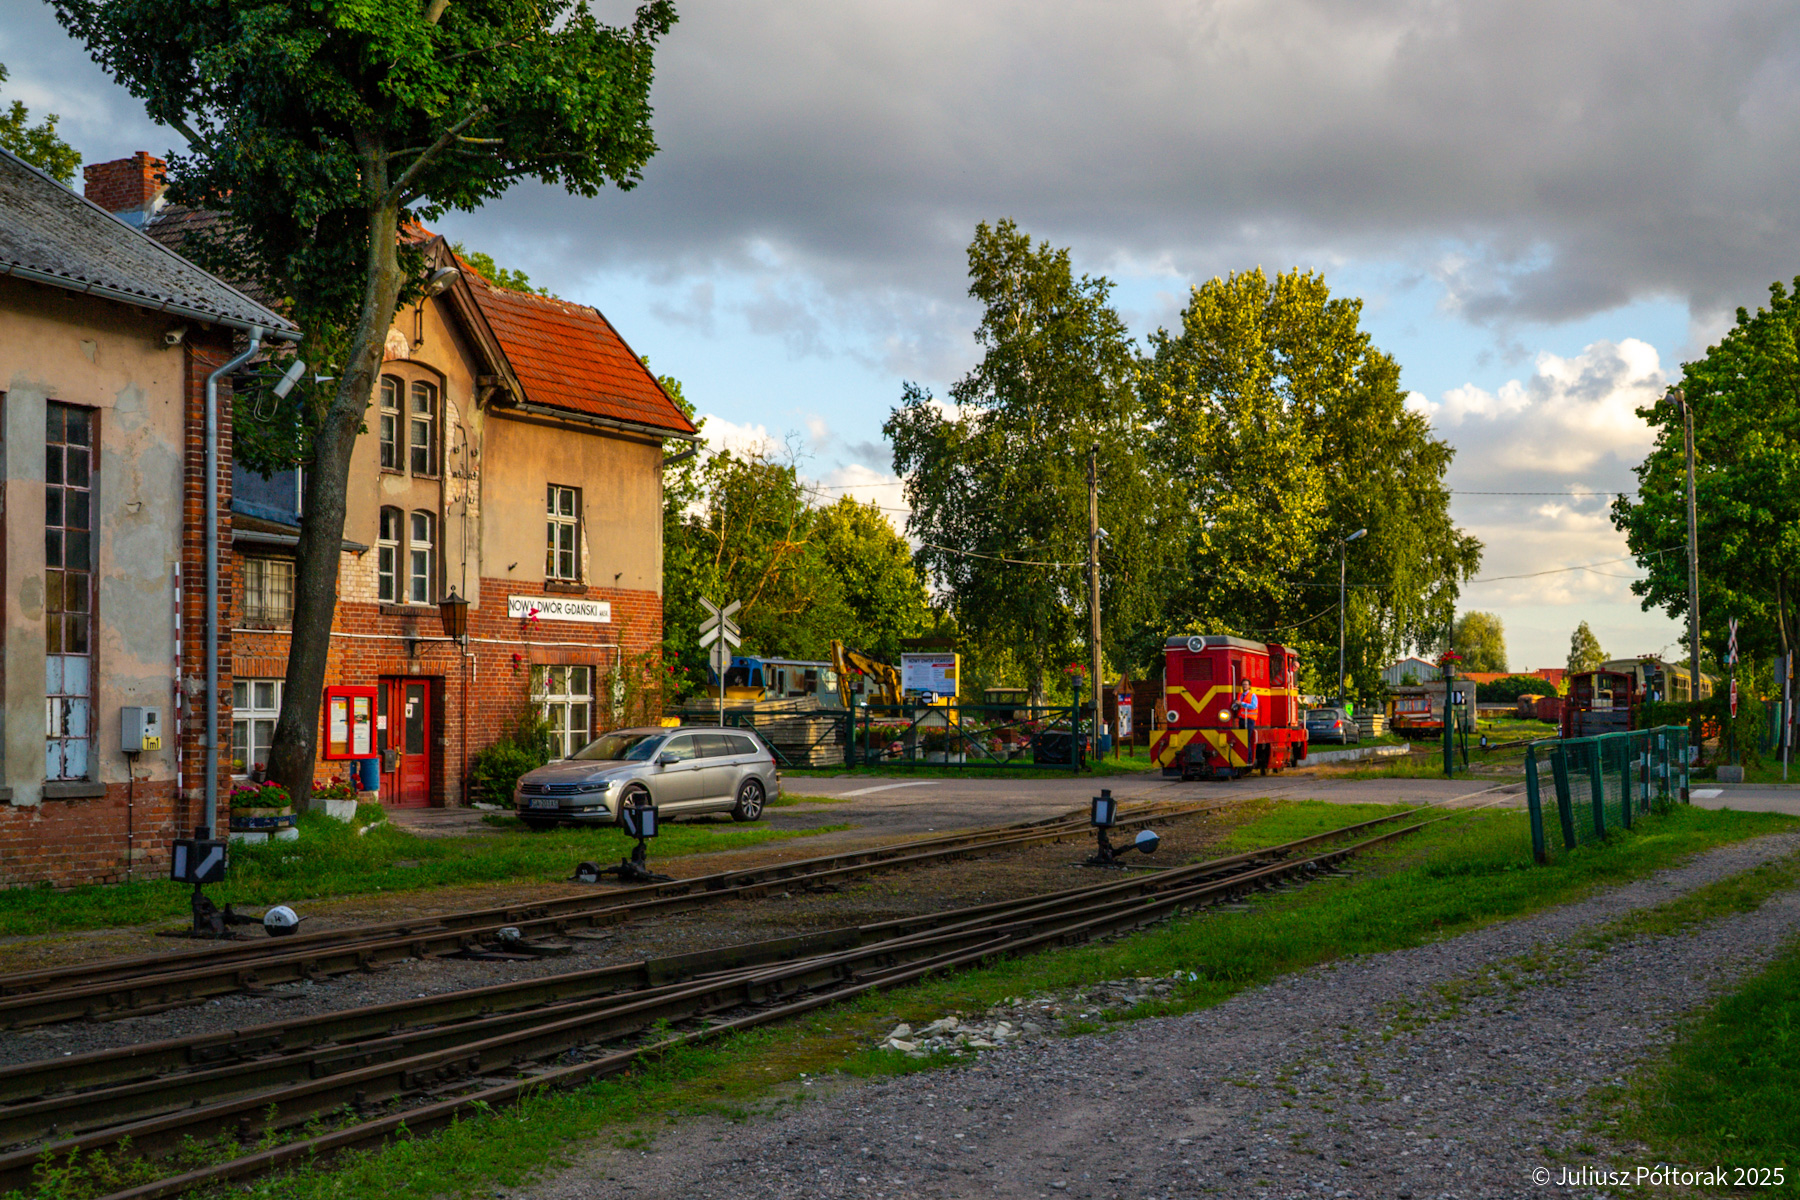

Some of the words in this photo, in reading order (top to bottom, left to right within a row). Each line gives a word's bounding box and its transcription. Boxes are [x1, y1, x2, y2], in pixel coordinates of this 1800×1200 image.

[509, 599, 535, 612] NOWY
[537, 600, 562, 614] DWÓR
[564, 602, 598, 616] GDAŃSKI
[145, 737, 159, 749] Tm1
